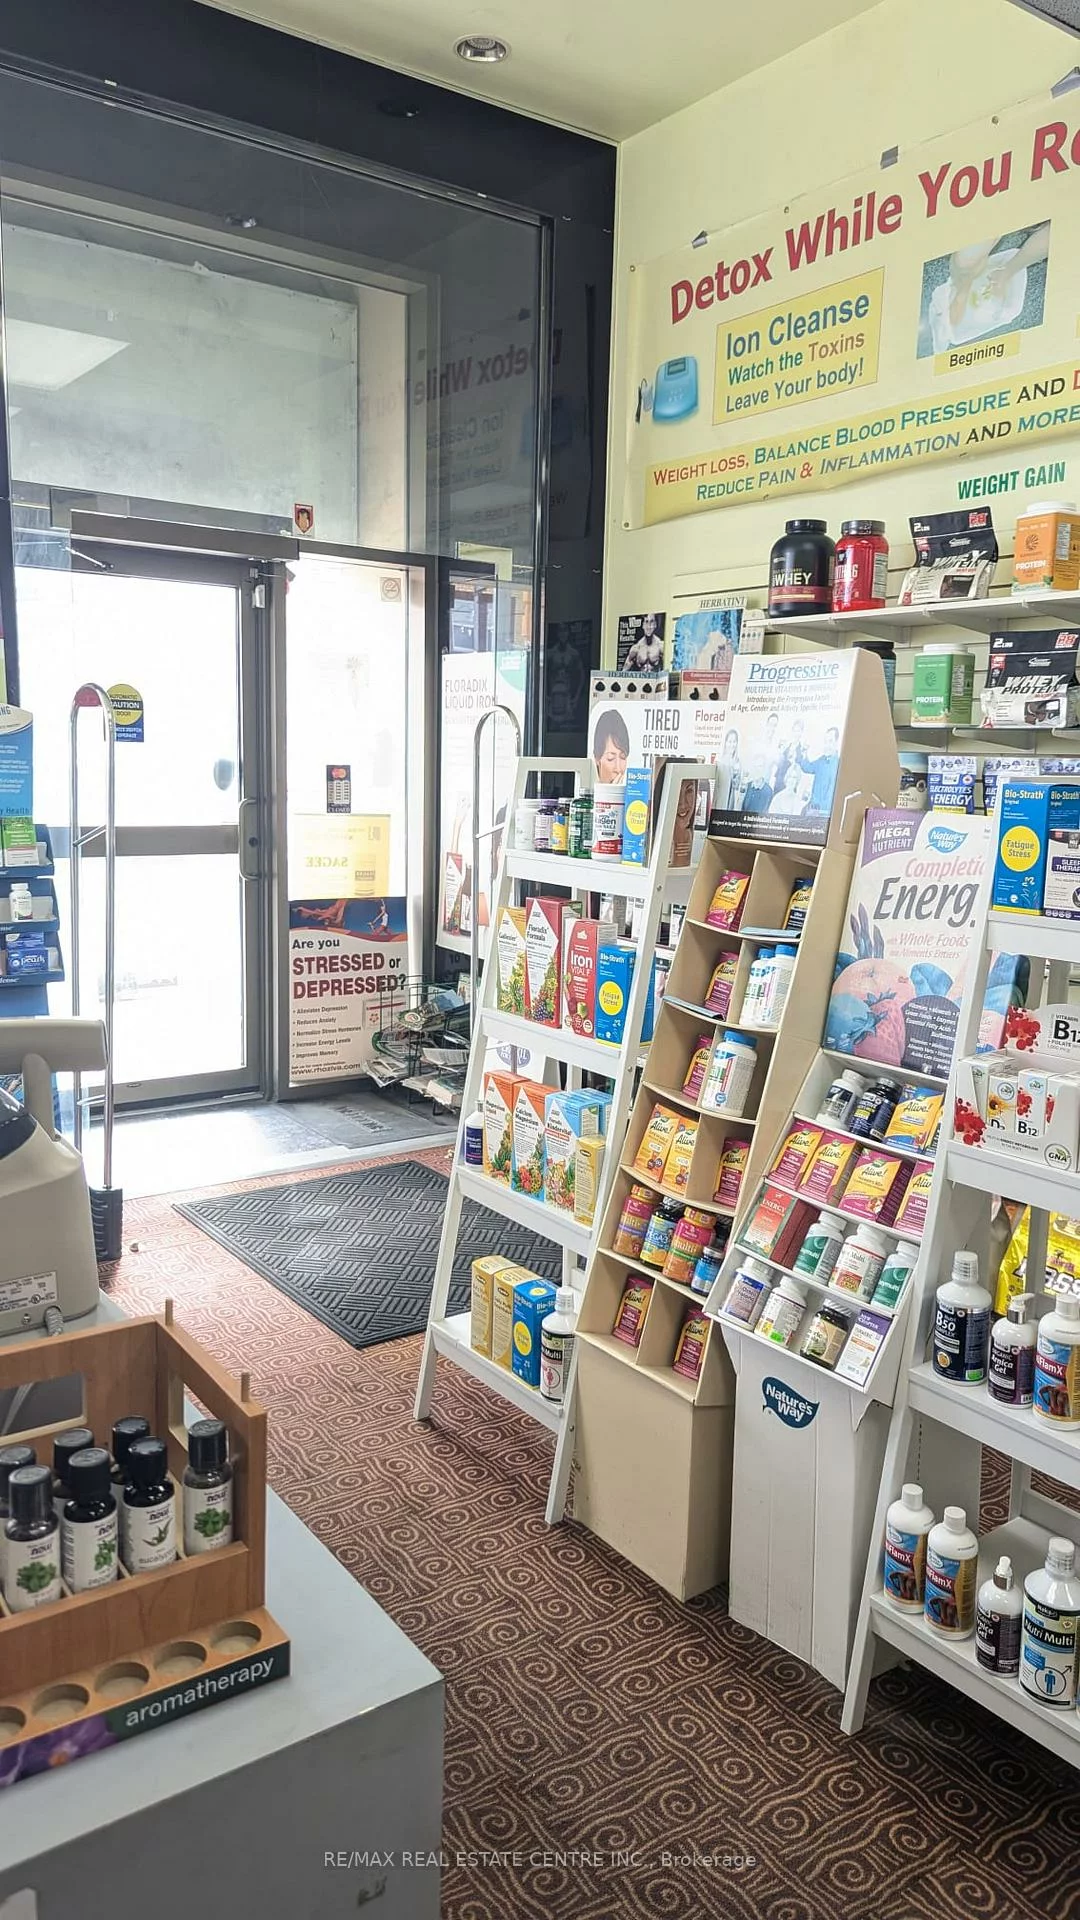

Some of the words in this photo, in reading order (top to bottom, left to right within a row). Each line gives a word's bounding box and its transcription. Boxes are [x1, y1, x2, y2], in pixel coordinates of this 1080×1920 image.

[671, 248, 773, 324] Detox
[785, 191, 902, 271] While
[918, 151, 1012, 218] You
[727, 331, 760, 360] Ion
[769, 295, 870, 345] Cleanse
[728, 358, 774, 386] Watch
[779, 352, 804, 371] the
[809, 332, 865, 361] Toxins
[949, 342, 1005, 368] Begining
[726, 390, 769, 413] Leave
[774, 377, 812, 399] Your
[817, 357, 864, 389] body!
[654, 464, 707, 486] WEIGHT
[711, 454, 749, 474] LOSS,
[755, 435, 831, 464] BALANCE
[836, 418, 895, 446] BLOOD
[901, 390, 1011, 430] PRESSURE
[1017, 377, 1066, 403] AND
[697, 477, 754, 500] REDUCE
[758, 468, 796, 488] PAIN
[800, 462, 813, 479] &
[820, 432, 960, 475] INFLAMMATION
[966, 421, 1012, 444] AND
[958, 471, 1020, 500] WEIGHT
[1024, 462, 1066, 489] GAIN
[1016, 560, 1046, 570] PROTEIN
[775, 573, 812, 586] WHEY
[748, 660, 840, 685] Progressive
[445, 678, 487, 693] FLORADIX
[1006, 675, 1067, 688] WHEY
[1002, 686, 1059, 695] PROTEIN
[916, 696, 944, 704] PROTEIN
[644, 708, 680, 731] TIRED
[642, 735, 653, 749] OF
[655, 735, 679, 750] BEING
[1004, 789, 1044, 799] Bio-Strath
[873, 827, 911, 841] MEGA
[871, 839, 912, 854] NUTRIENT
[1006, 840, 1035, 851] Fatigue
[1008, 848, 1031, 859] Stress
[873, 877, 980, 928] Energ
[292, 939, 314, 949] Are
[318, 939, 340, 950] you
[293, 952, 384, 975] STRESSED
[389, 958, 401, 969] or
[570, 952, 593, 968] Iron
[293, 973, 406, 999] DEPRESSED?
[904, 1102, 933, 1114] Alive!
[1018, 1120, 1038, 1137] B12
[1048, 1151, 1068, 1163] GNA
[861, 1167, 888, 1177] Alive!
[994, 1364, 1007, 1375] Gel
[766, 1383, 814, 1415] Nature's
[777, 1402, 805, 1422] Way
[1044, 1632, 1073, 1646] Multi
[125, 1656, 275, 1727] aromatherapy
